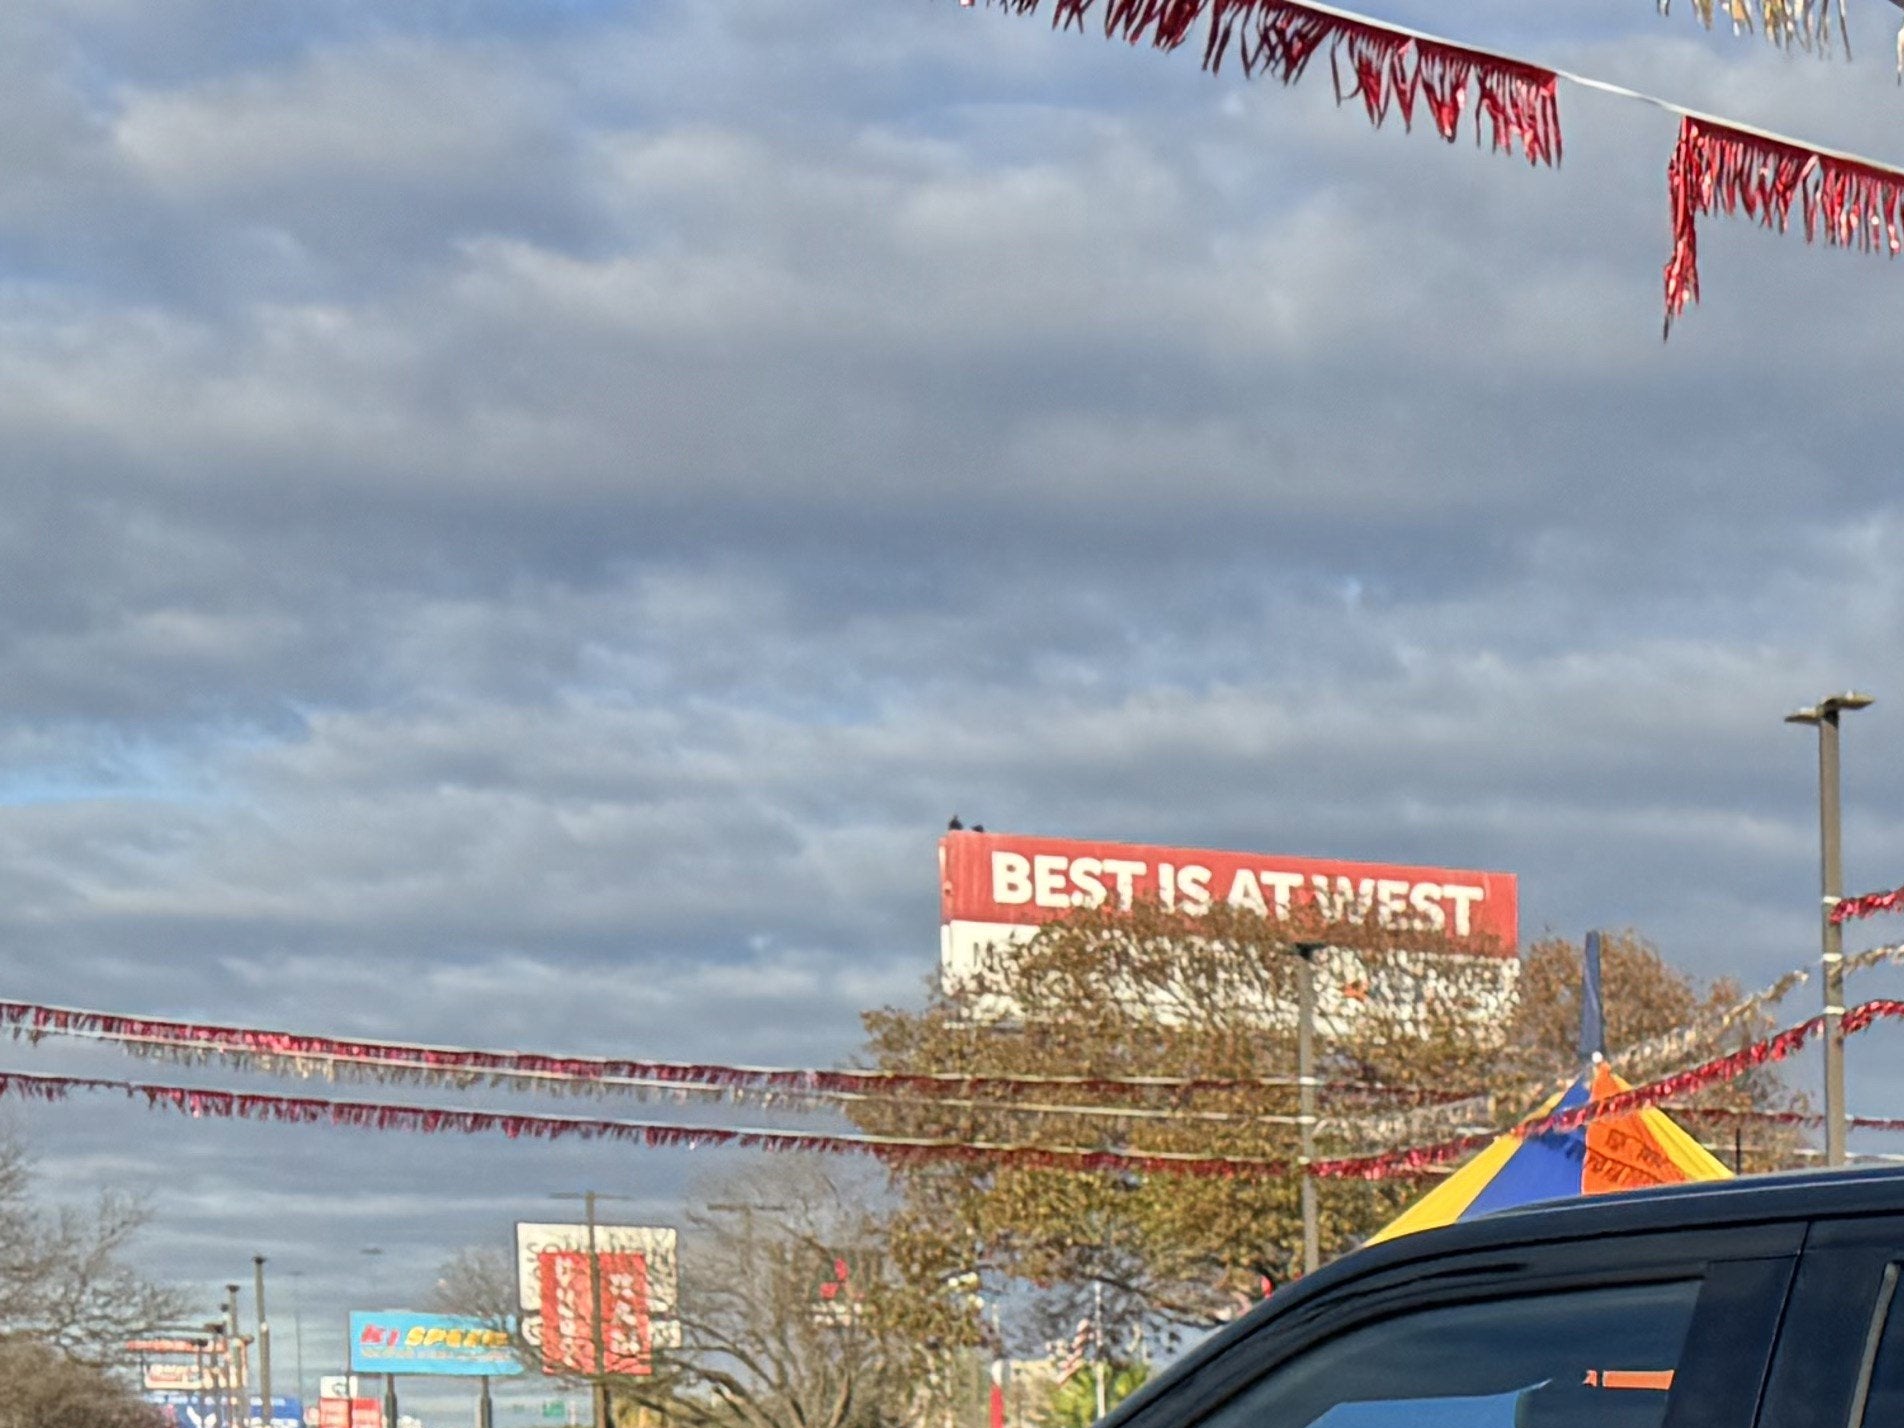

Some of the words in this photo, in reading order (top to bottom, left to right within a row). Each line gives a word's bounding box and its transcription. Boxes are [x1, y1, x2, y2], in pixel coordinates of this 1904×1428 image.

[991, 851, 1146, 912] BEST
[1158, 863, 1213, 915] IS
[1227, 869, 1303, 922] AT
[1312, 876, 1485, 936] WEST
